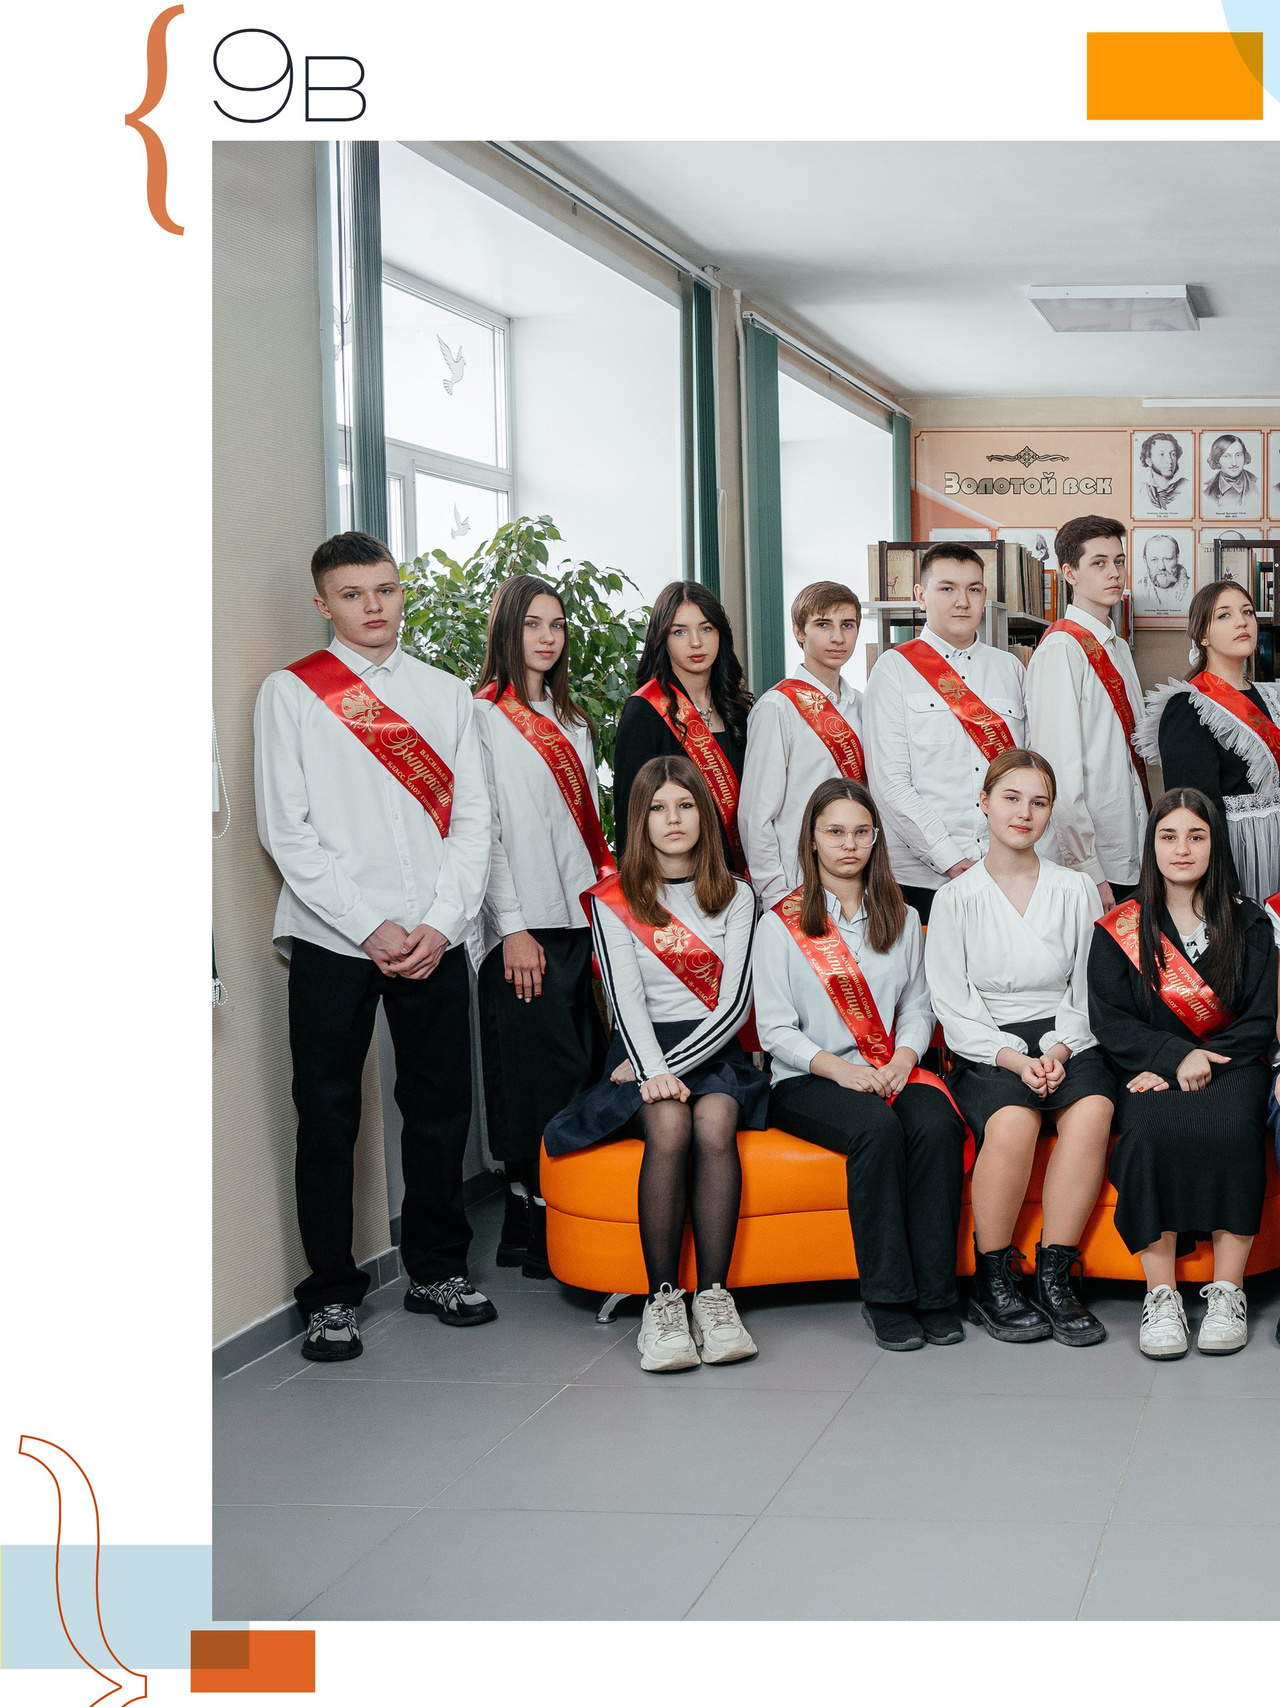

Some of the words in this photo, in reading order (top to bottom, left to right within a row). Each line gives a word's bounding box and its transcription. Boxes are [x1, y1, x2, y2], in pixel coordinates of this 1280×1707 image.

[944, 471, 1057, 495] Золотой
[1062, 476, 1113, 495] век
[381, 722, 452, 807] Выпускник
[686, 720, 735, 809] Выпускница
[808, 930, 865, 1021] Выпускница
[861, 997, 873, 1019] СОФИЯ
